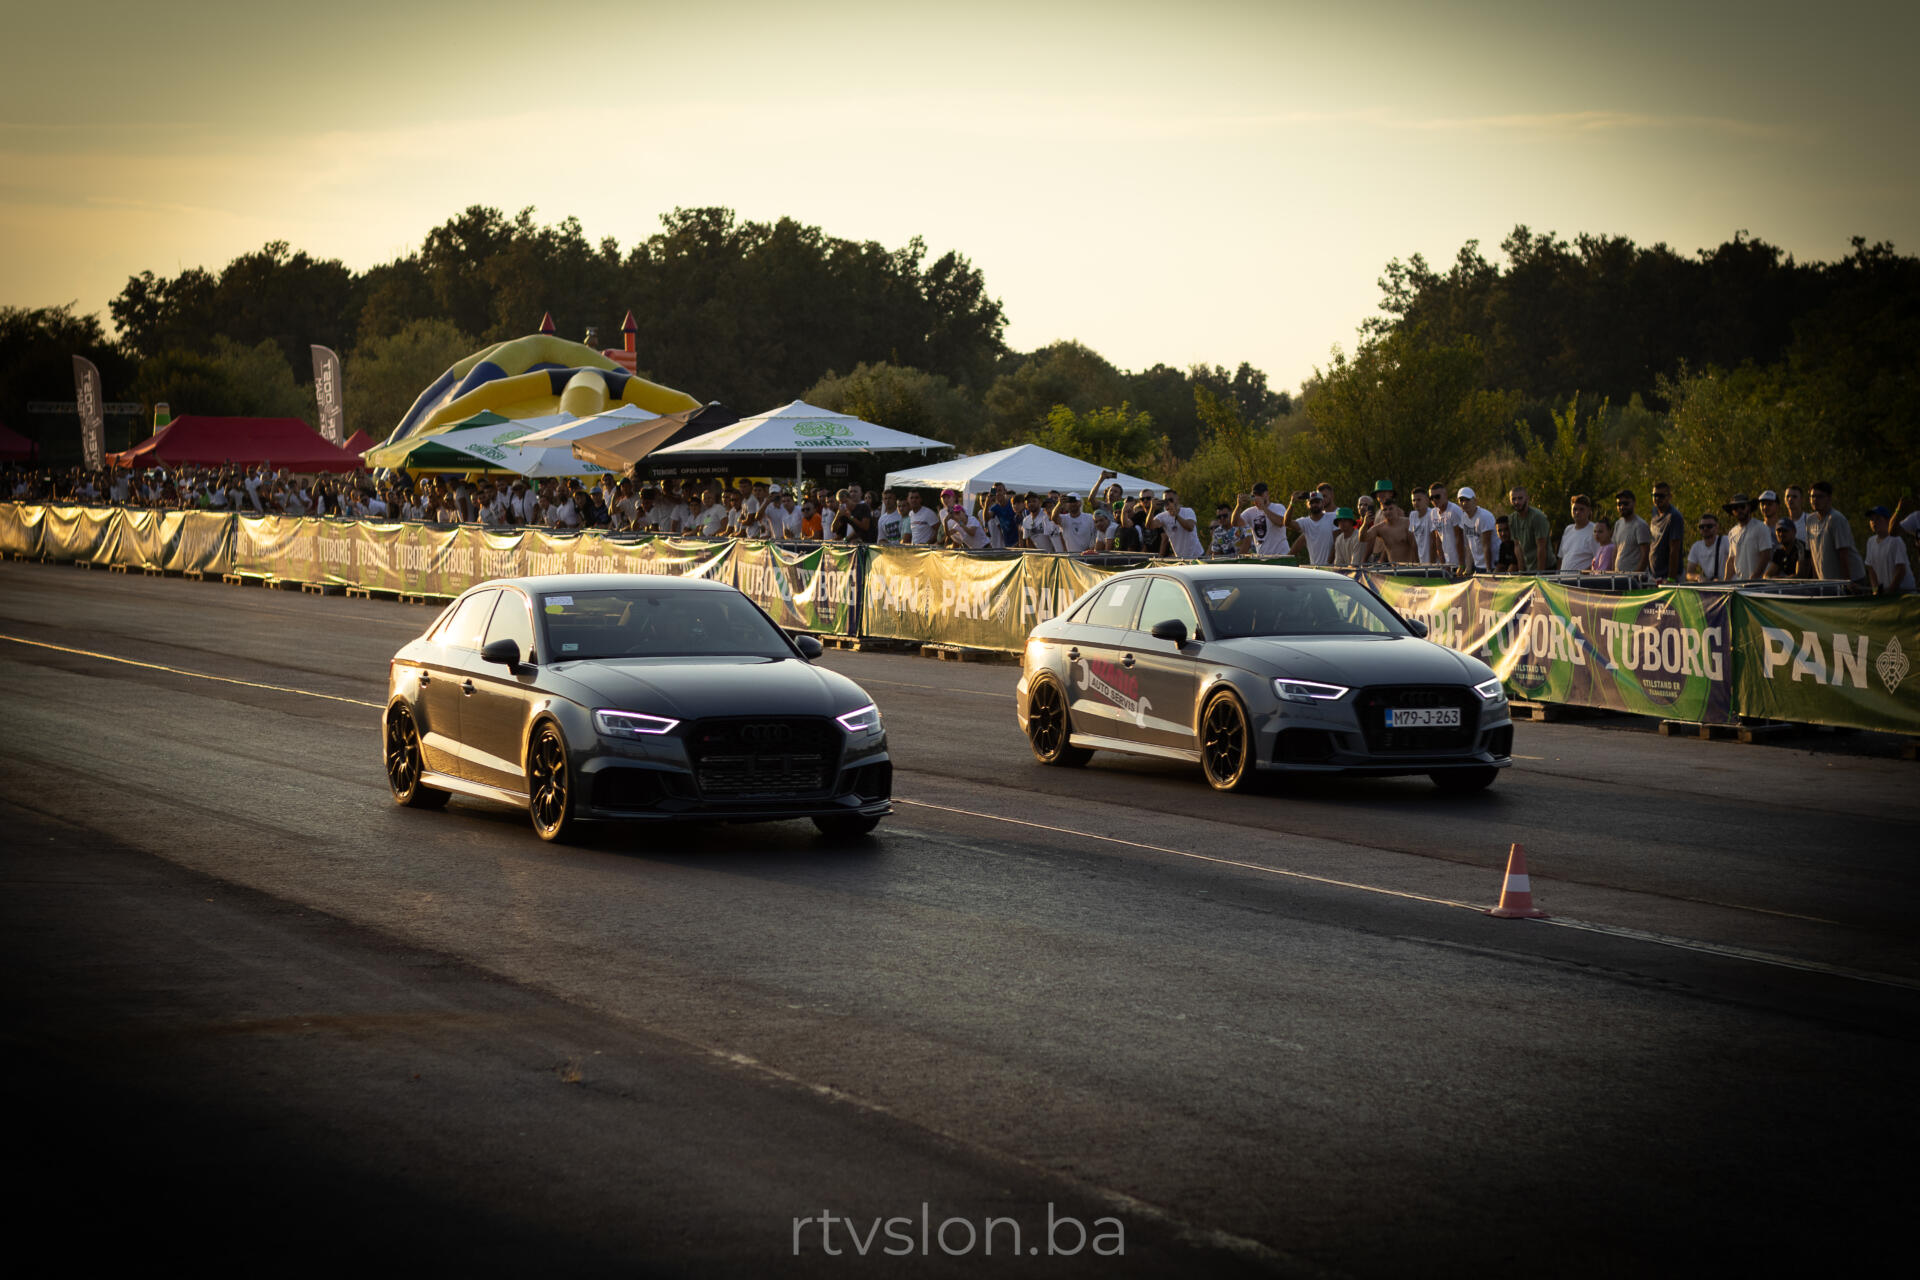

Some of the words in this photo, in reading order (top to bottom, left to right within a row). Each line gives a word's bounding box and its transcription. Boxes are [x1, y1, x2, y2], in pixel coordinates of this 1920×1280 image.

[317, 536, 350, 565] TUBORG
[394, 542, 431, 573] TUBORG
[437, 546, 474, 576] TUBORG
[480, 549, 520, 578] TUBORG
[867, 574, 920, 613] PAN
[942, 578, 991, 620] PAN
[1600, 617, 1724, 682] TUBORG
[1761, 625, 1870, 689] PAN
[1091, 677, 1110, 696] AUTO
[1110, 690, 1136, 712] SERVIS
[1394, 710, 1459, 725] M79-J-263
